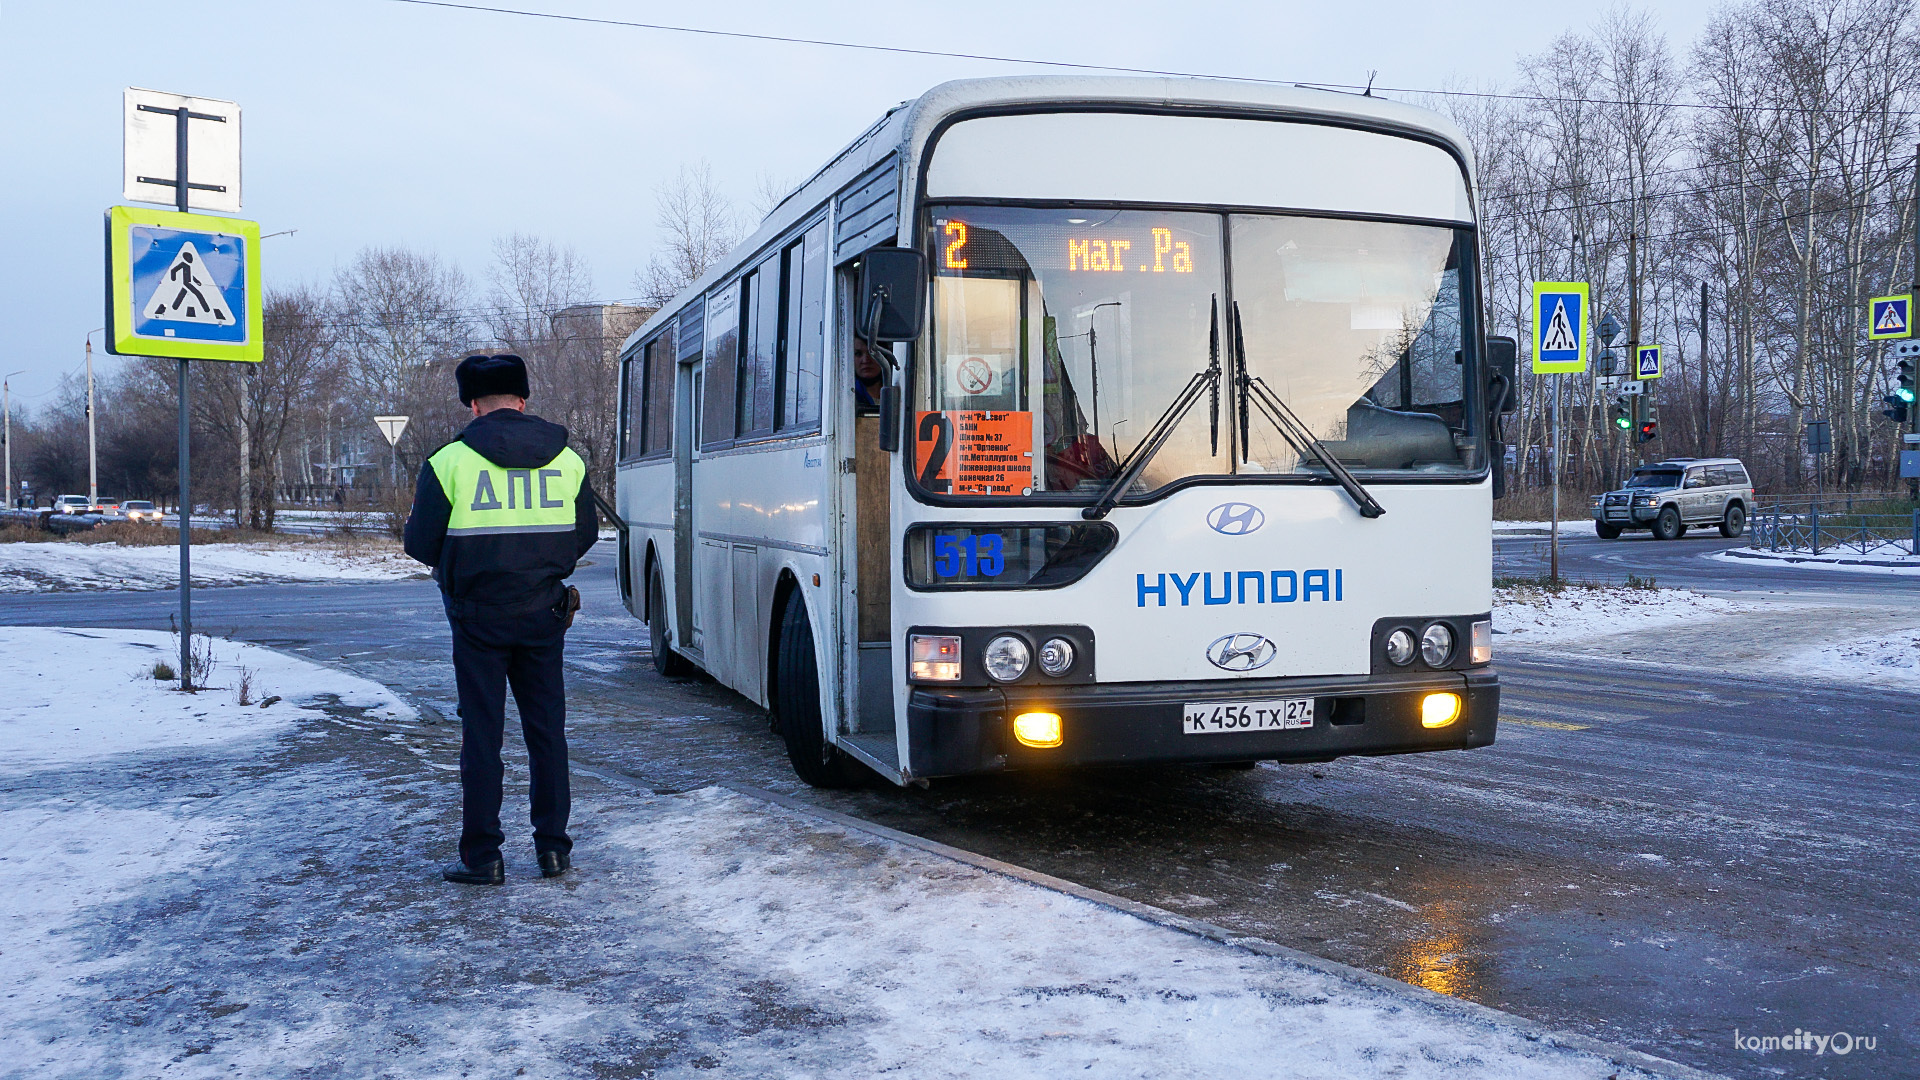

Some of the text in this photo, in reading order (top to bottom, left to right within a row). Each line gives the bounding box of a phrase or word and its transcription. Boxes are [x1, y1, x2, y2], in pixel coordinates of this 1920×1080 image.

[945, 222, 968, 269] 2
[1068, 238, 1131, 272] маг
[973, 411, 1010, 422] "Расвет"
[959, 423, 978, 431] БАНИ
[959, 433, 985, 442] Школа
[994, 433, 1003, 442] 37
[918, 412, 955, 493] 2
[959, 463, 1006, 472] Инженерная
[959, 473, 1005, 482] конечная 26
[471, 469, 564, 511] ДПС
[934, 533, 1005, 578] 513
[1136, 568, 1343, 608] HYUNDAI
[1287, 701, 1307, 720] 27
[1285, 718, 1300, 726] RUS
